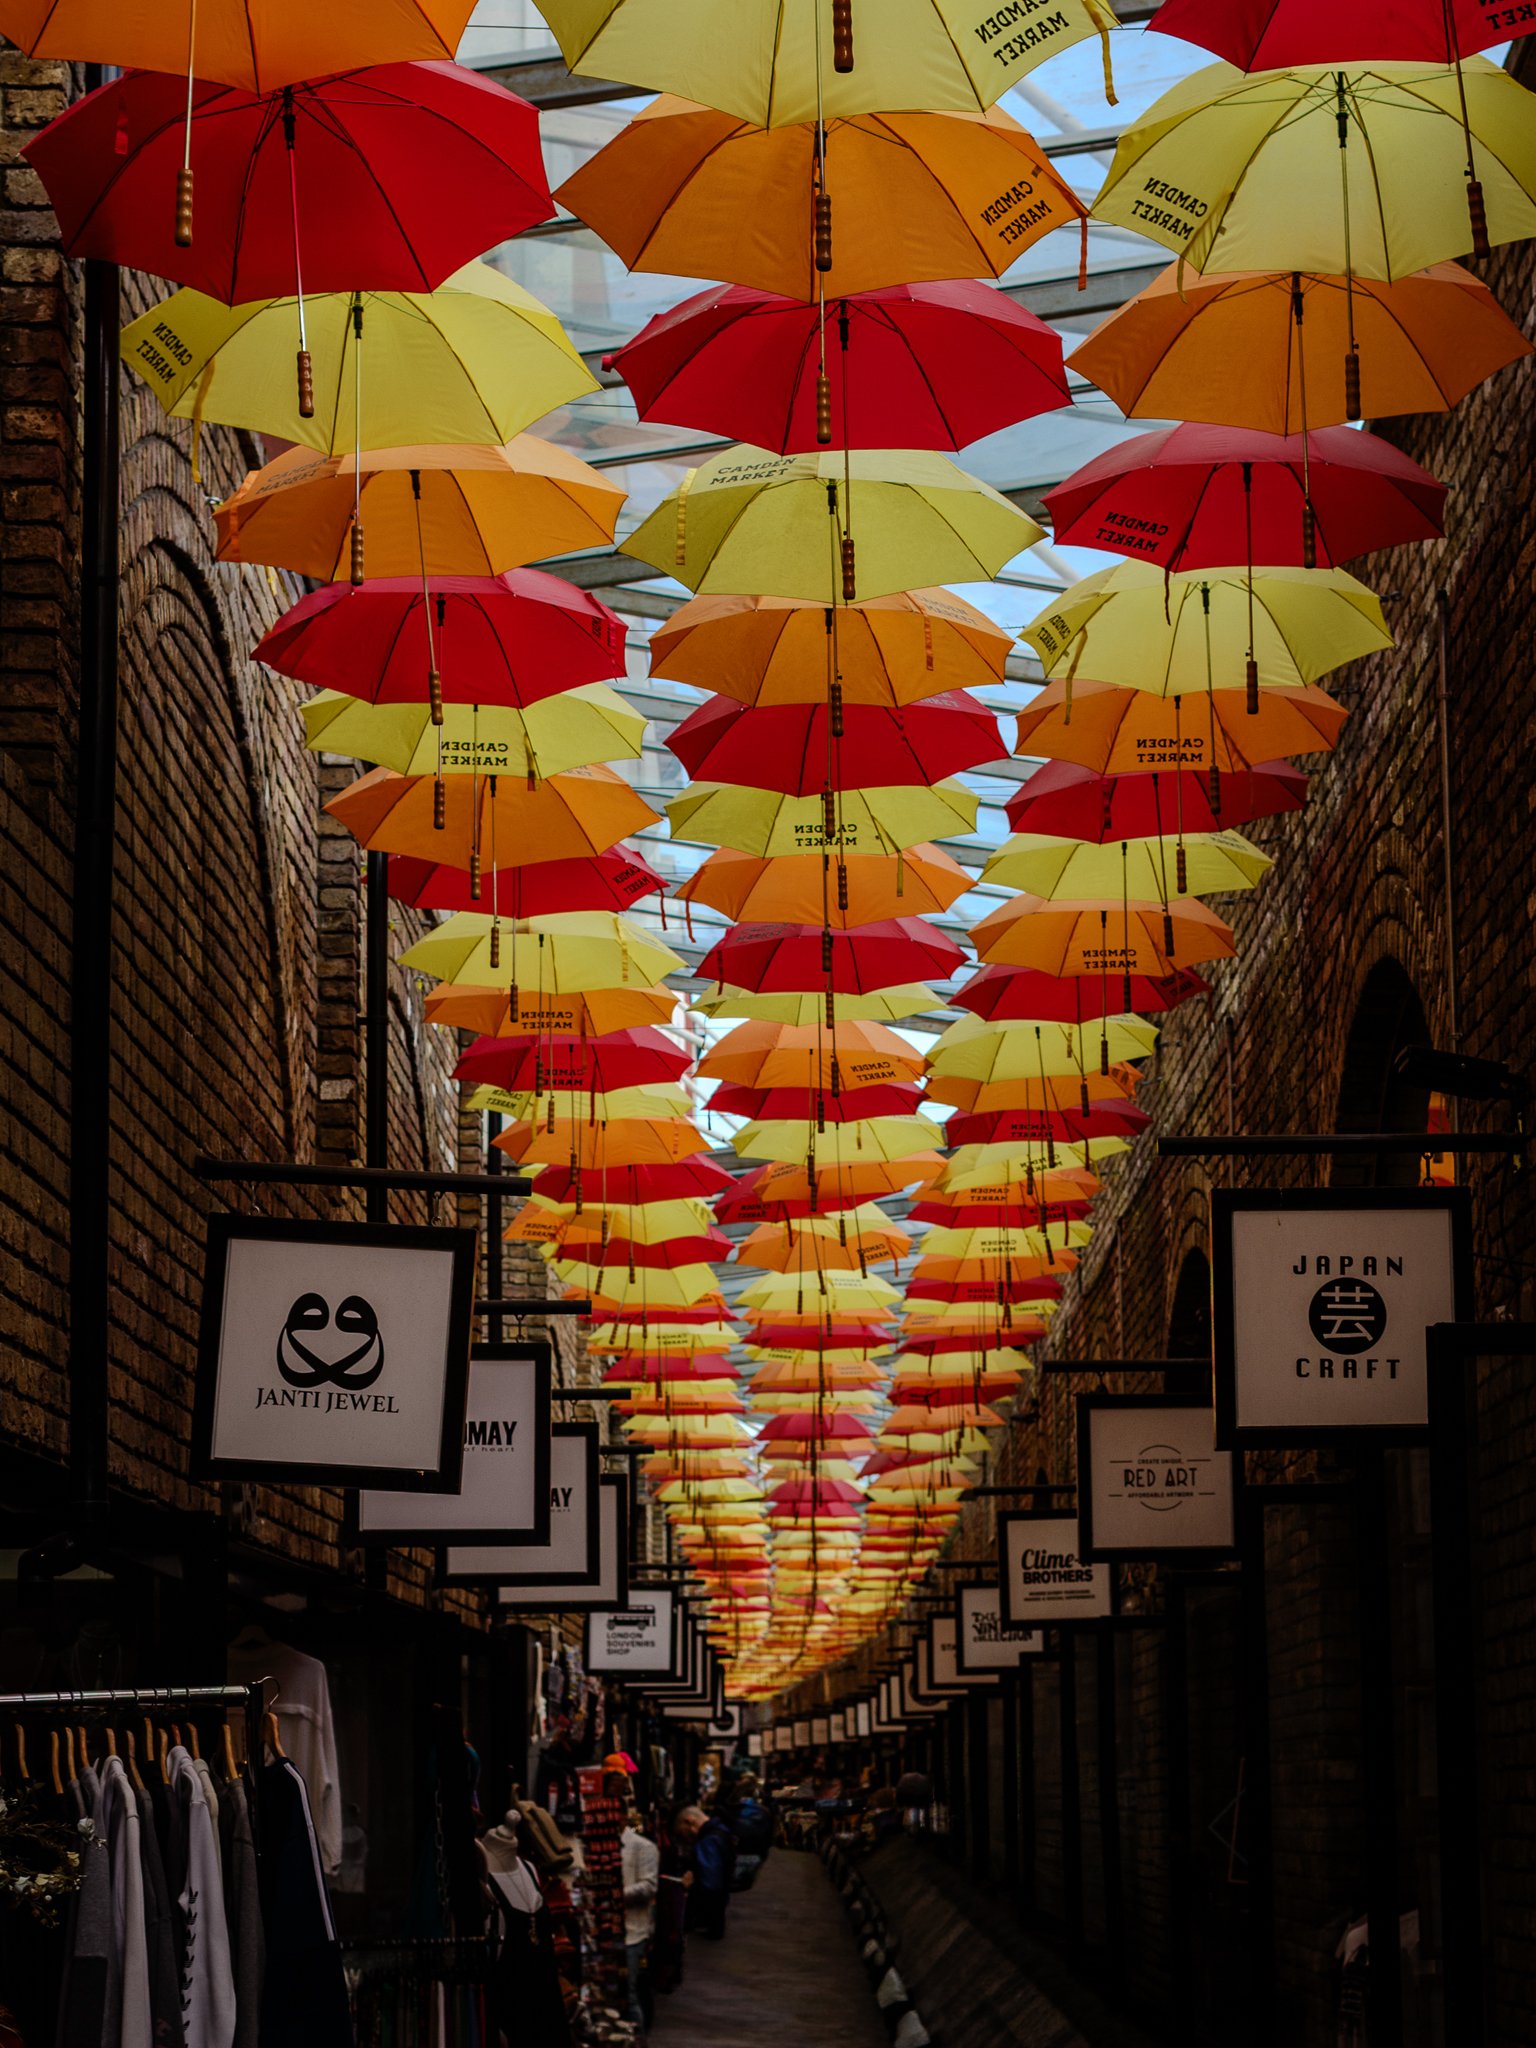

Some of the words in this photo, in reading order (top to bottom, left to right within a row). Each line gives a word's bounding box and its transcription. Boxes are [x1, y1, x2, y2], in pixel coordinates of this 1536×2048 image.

[718, 458, 797, 474] CAMDEN
[710, 468, 788, 485] MARKET
[1293, 1256, 1402, 1275] JAPAN
[1321, 1286, 1375, 1341] 芸
[1296, 1358, 1400, 1378] CRAFT
[256, 1388, 321, 1409] JANTI
[325, 1392, 399, 1413] JEWEL
[464, 1421, 517, 1445] MAY
[1124, 1469, 1156, 1487] RED
[1165, 1468, 1197, 1486] ART
[1024, 1570, 1093, 1584] BROTHERS
